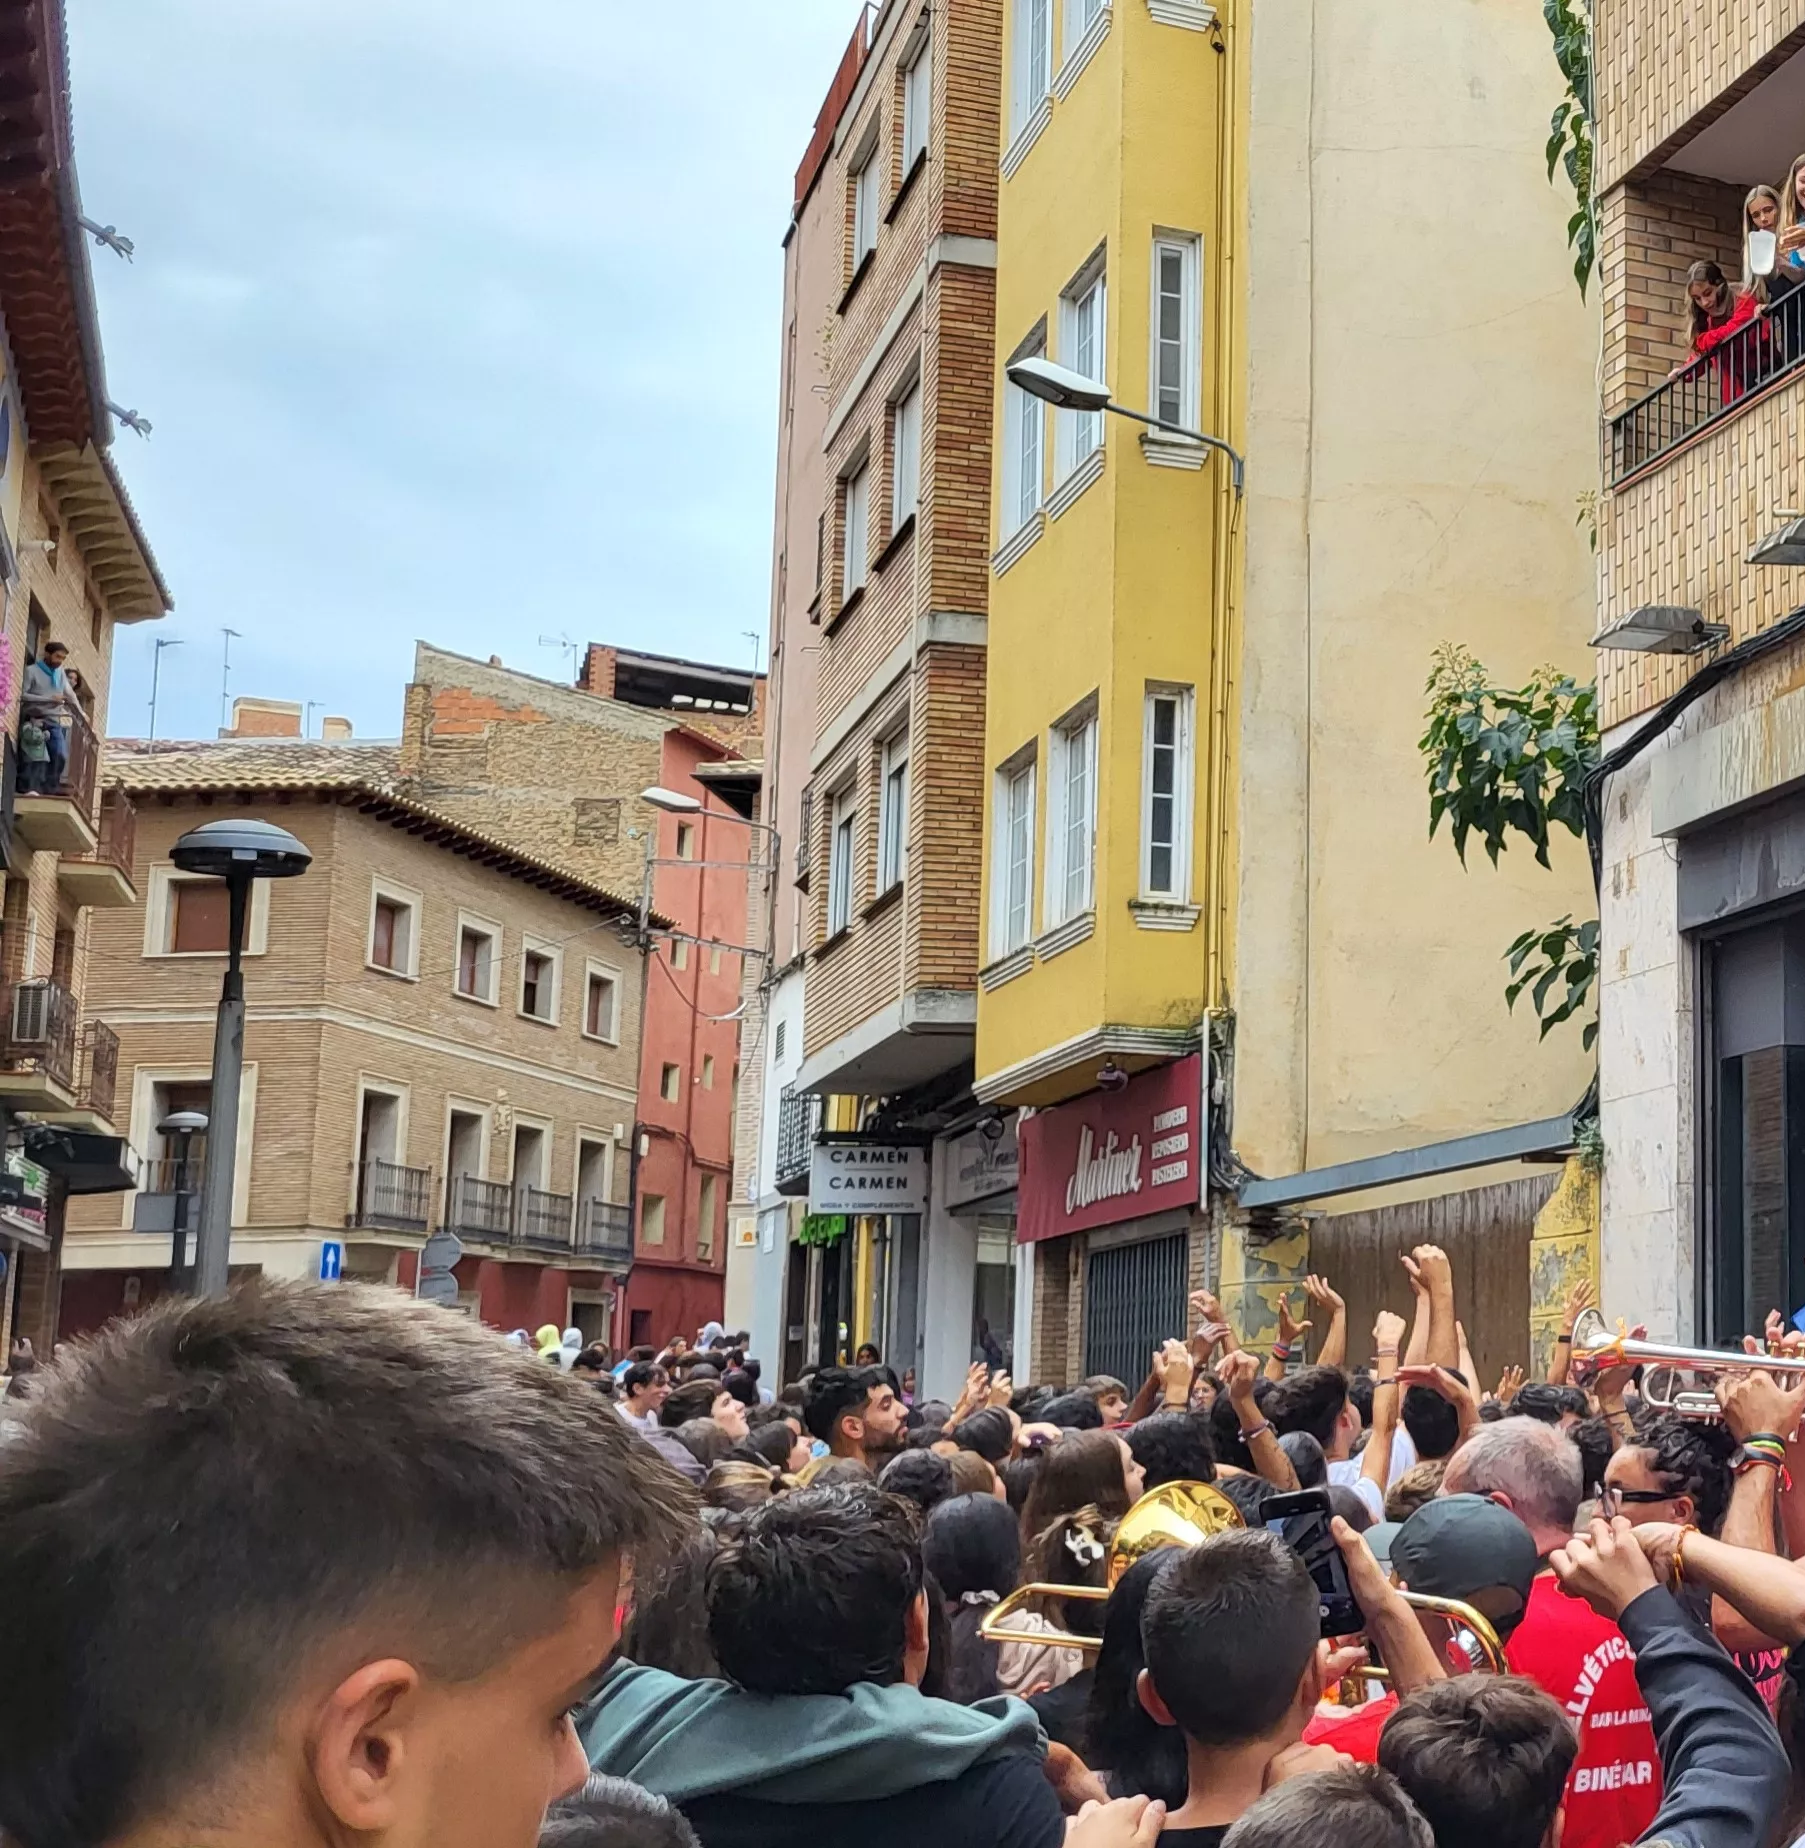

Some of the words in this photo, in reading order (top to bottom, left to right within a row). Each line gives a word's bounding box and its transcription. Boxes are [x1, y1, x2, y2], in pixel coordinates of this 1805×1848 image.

[830, 1150, 909, 1164] CARMEN
[829, 1176, 908, 1190] CARMEN
[1567, 1636, 1638, 1717] LVÉTICO
[1591, 1711, 1613, 1729] BAR
[1614, 1709, 1628, 1726] LA
[1573, 1758, 1653, 1793] BINÉAR
